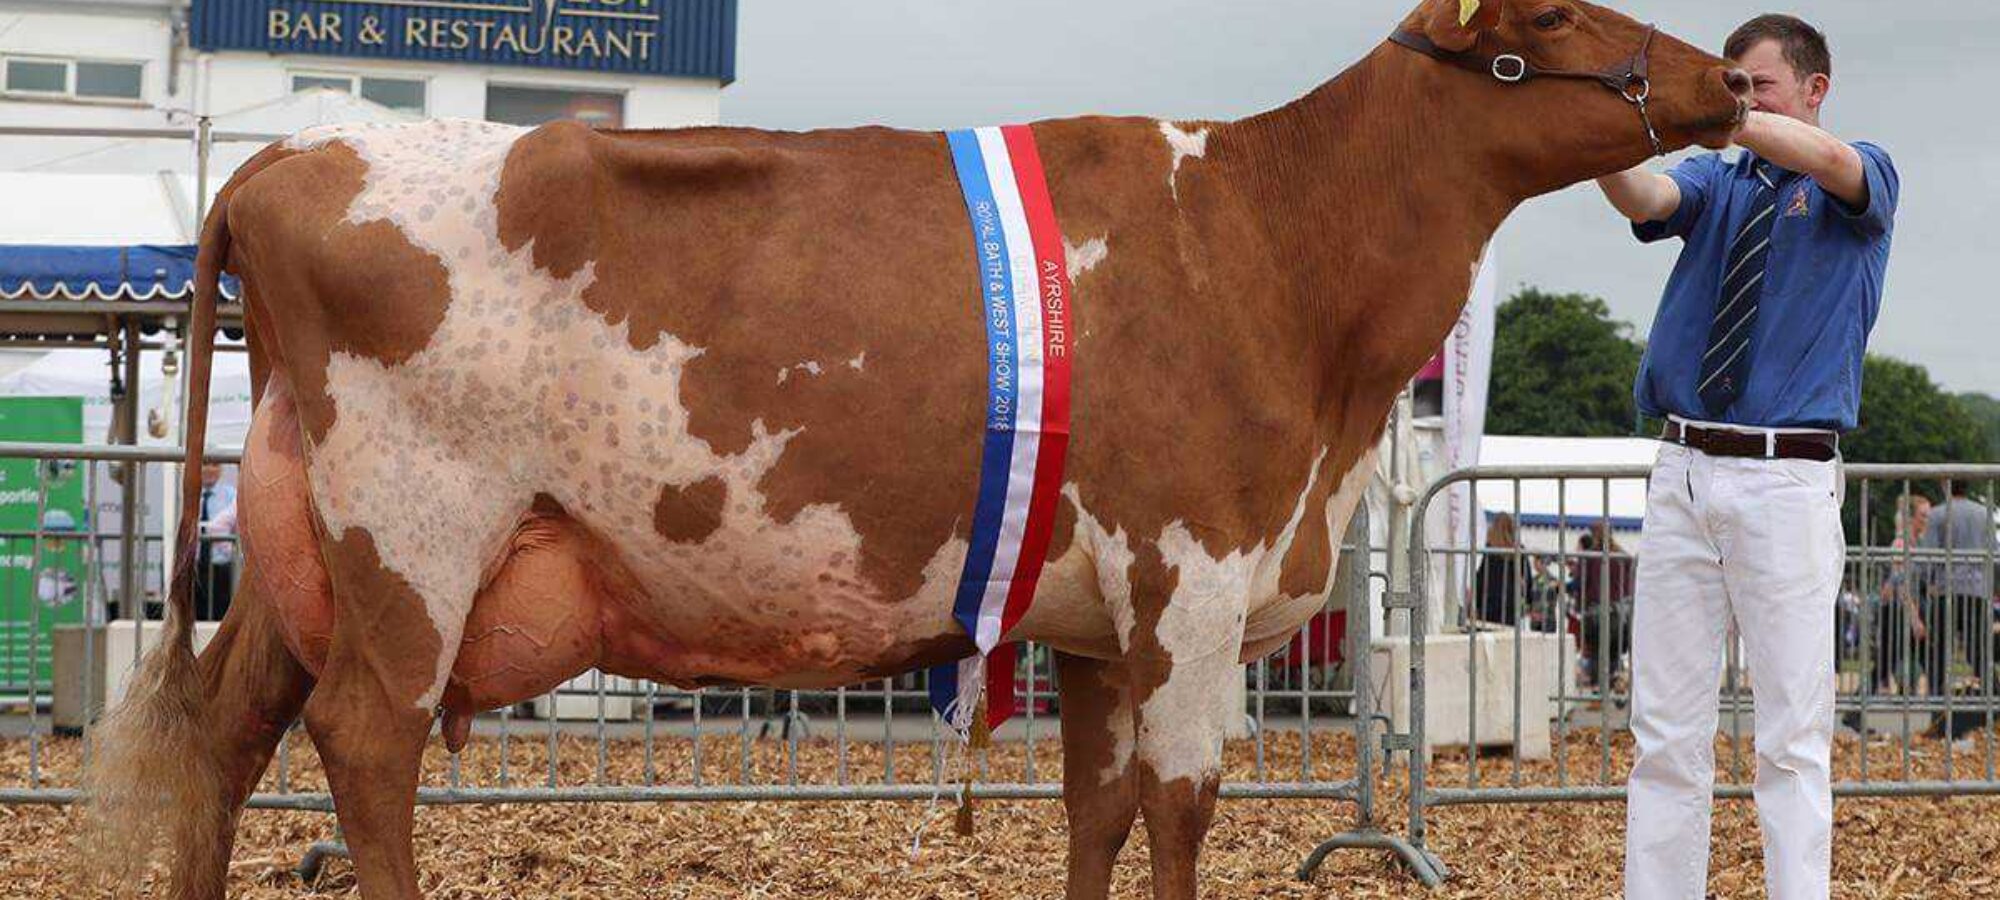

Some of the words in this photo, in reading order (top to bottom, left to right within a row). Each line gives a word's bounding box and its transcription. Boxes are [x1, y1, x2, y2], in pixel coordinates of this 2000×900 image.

[268, 9, 342, 42] BAR
[358, 15, 386, 45] &
[405, 17, 656, 60] RESTAURANT
[976, 201, 993, 241] ROYAL
[984, 242, 1003, 278] BATH
[989, 282, 1004, 291] &
[1043, 259, 1065, 357] AYRSHIRE
[992, 294, 1009, 339] WEST
[995, 342, 1010, 392] SHOW
